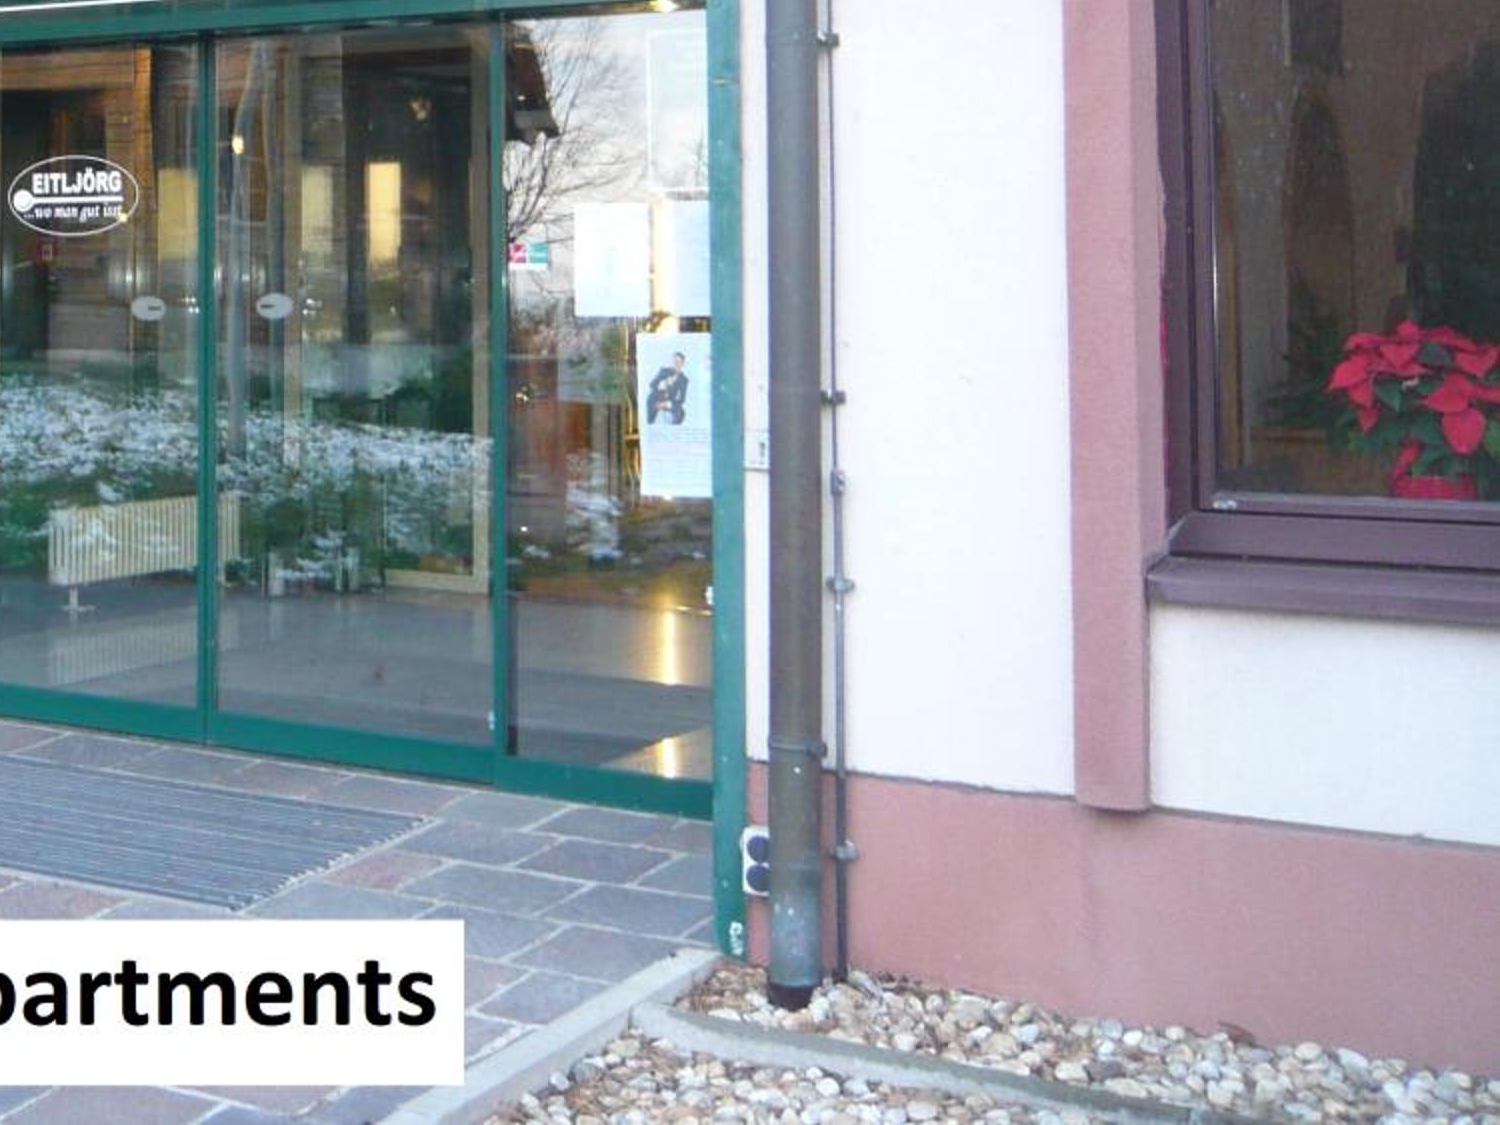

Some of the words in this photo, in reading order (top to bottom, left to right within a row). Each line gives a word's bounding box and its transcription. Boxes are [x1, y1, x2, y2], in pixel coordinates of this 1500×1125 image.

[32, 167, 123, 195] EITLJÖRG
[54, 206, 79, 219] man
[79, 205, 101, 223] gut
